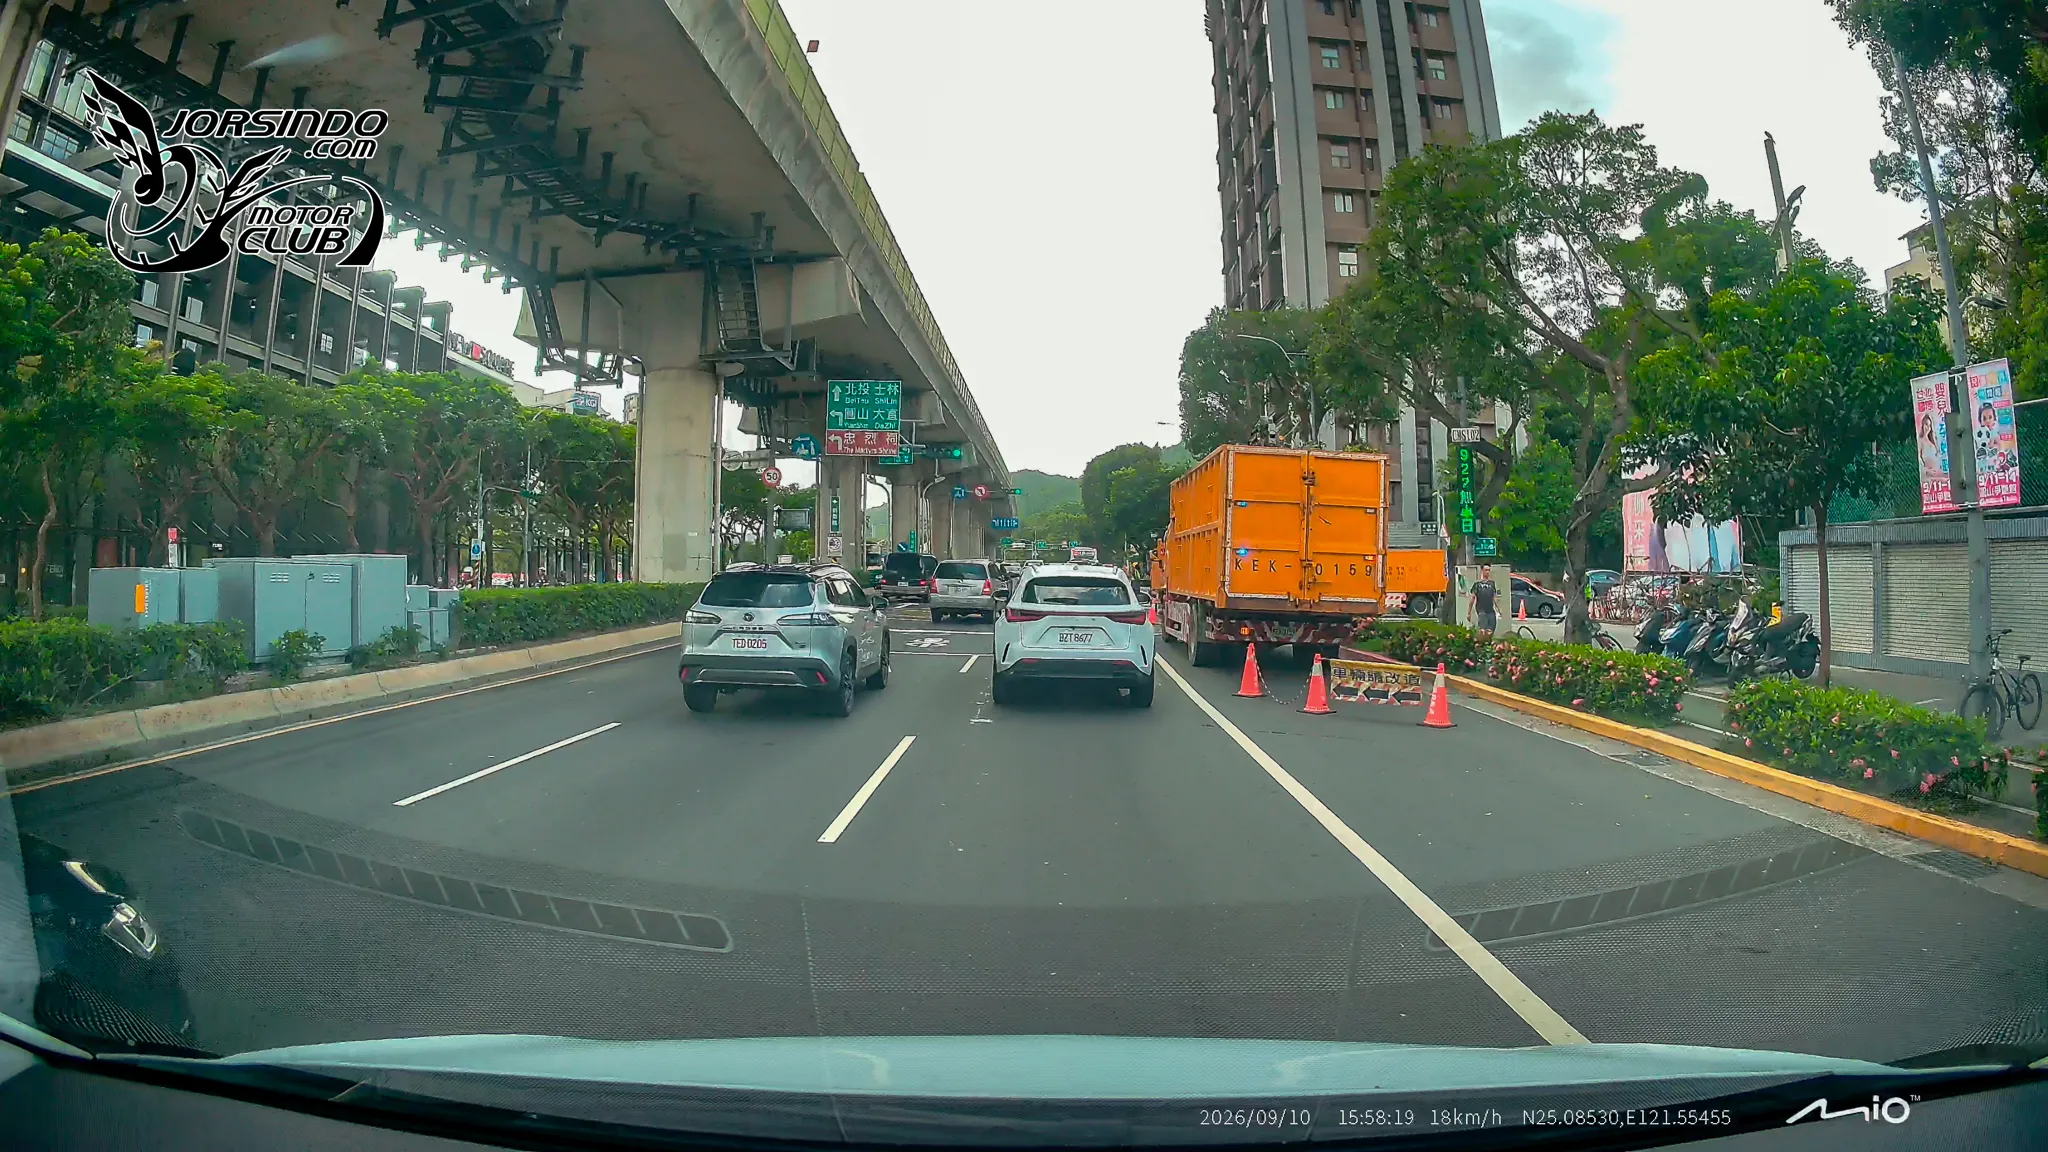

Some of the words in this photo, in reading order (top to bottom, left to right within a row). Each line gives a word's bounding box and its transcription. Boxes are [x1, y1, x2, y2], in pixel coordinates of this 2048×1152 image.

[845, 383, 870, 395] 北投
[874, 383, 899, 395] 士林
[845, 408, 869, 420] 圓山
[873, 408, 898, 421] 大直
[843, 431, 898, 446] 忠烈祠
[766, 472, 778, 481] 50
